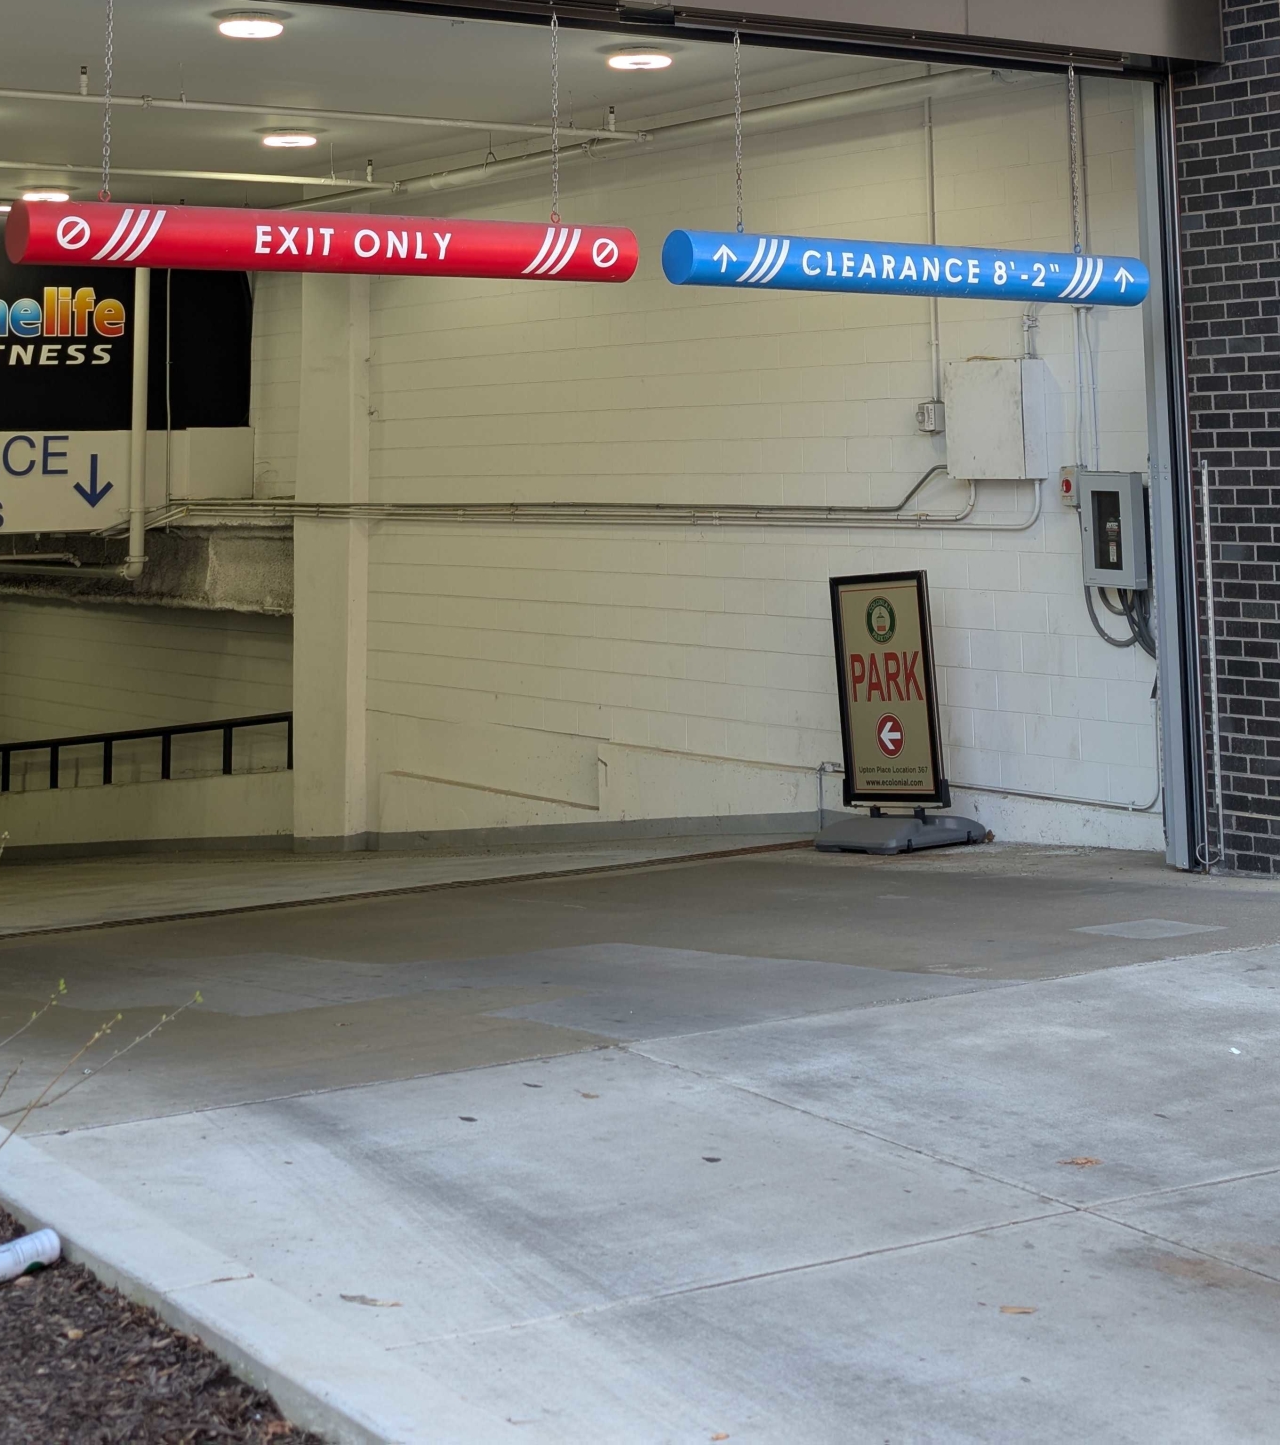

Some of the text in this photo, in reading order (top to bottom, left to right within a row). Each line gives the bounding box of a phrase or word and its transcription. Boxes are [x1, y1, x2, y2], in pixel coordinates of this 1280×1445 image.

[254, 225, 452, 260] EXIT ONLY
[802, 249, 980, 284] CLEARANCE
[849, 650, 924, 702] PARK
[858, 766, 876, 774] Upton
[892, 765, 917, 773] Location
[865, 778, 924, 786] www.ecolonial.com
